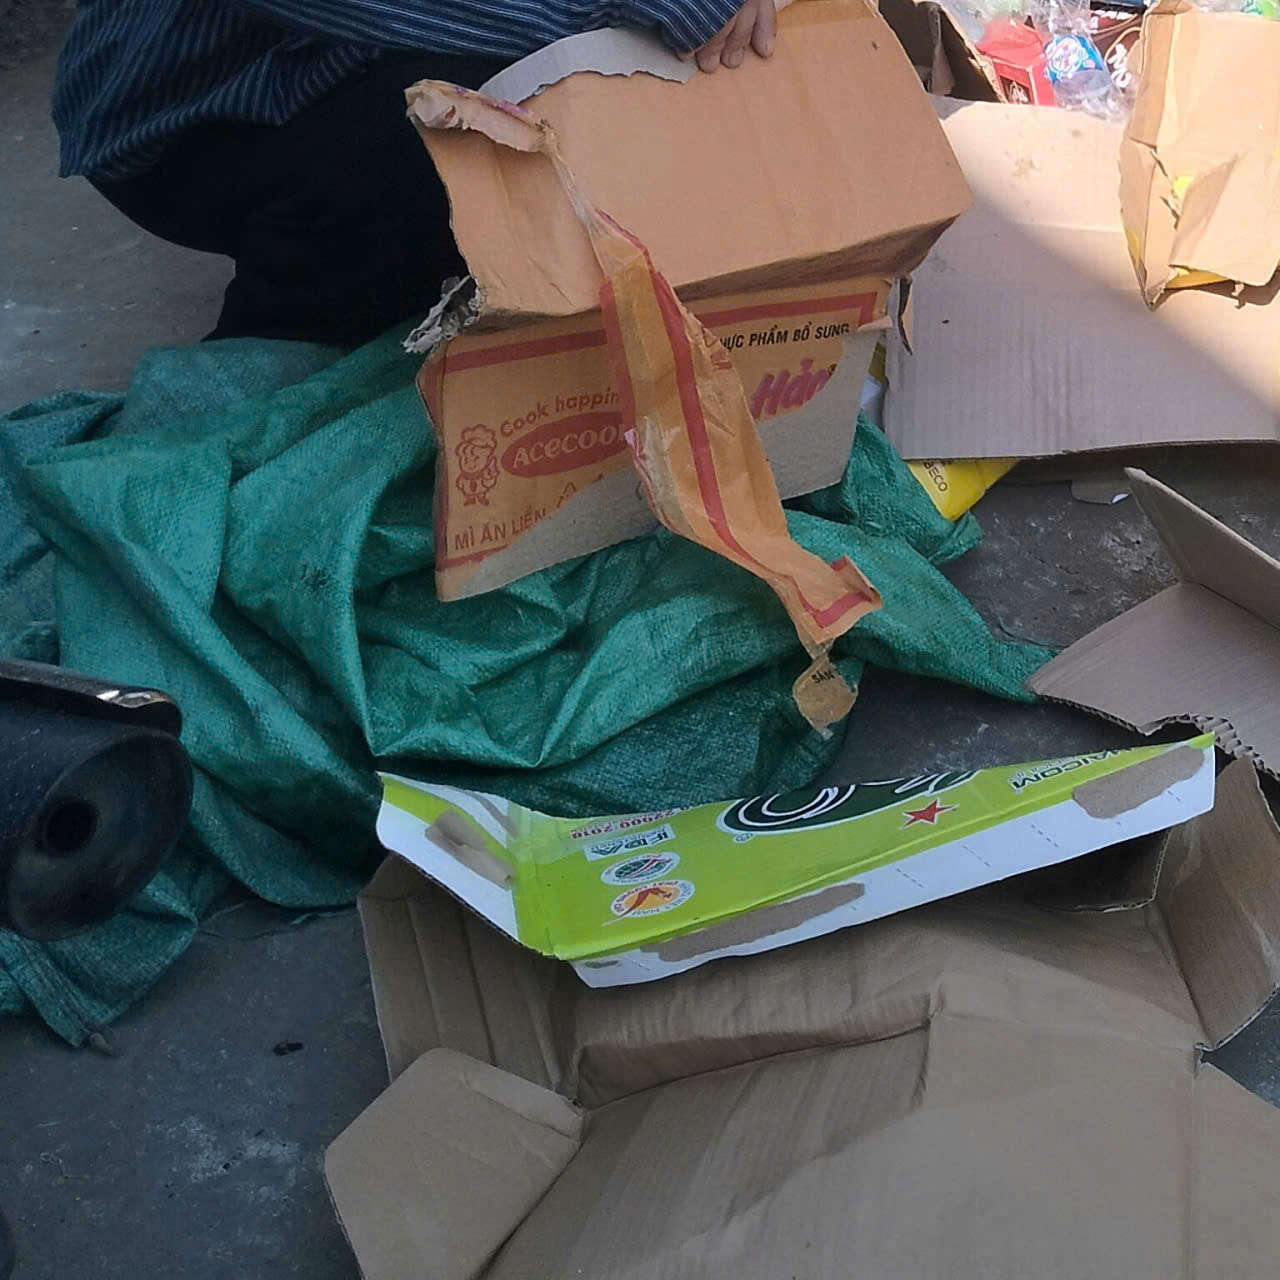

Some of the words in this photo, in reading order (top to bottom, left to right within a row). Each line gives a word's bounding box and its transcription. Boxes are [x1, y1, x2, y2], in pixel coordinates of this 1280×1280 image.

[748, 324, 788, 347] PHẨM
[793, 321, 813, 342] BỔ
[815, 322, 850, 340] SUNG
[454, 525, 475, 551] MÌ
[480, 520, 507, 545] ĂN
